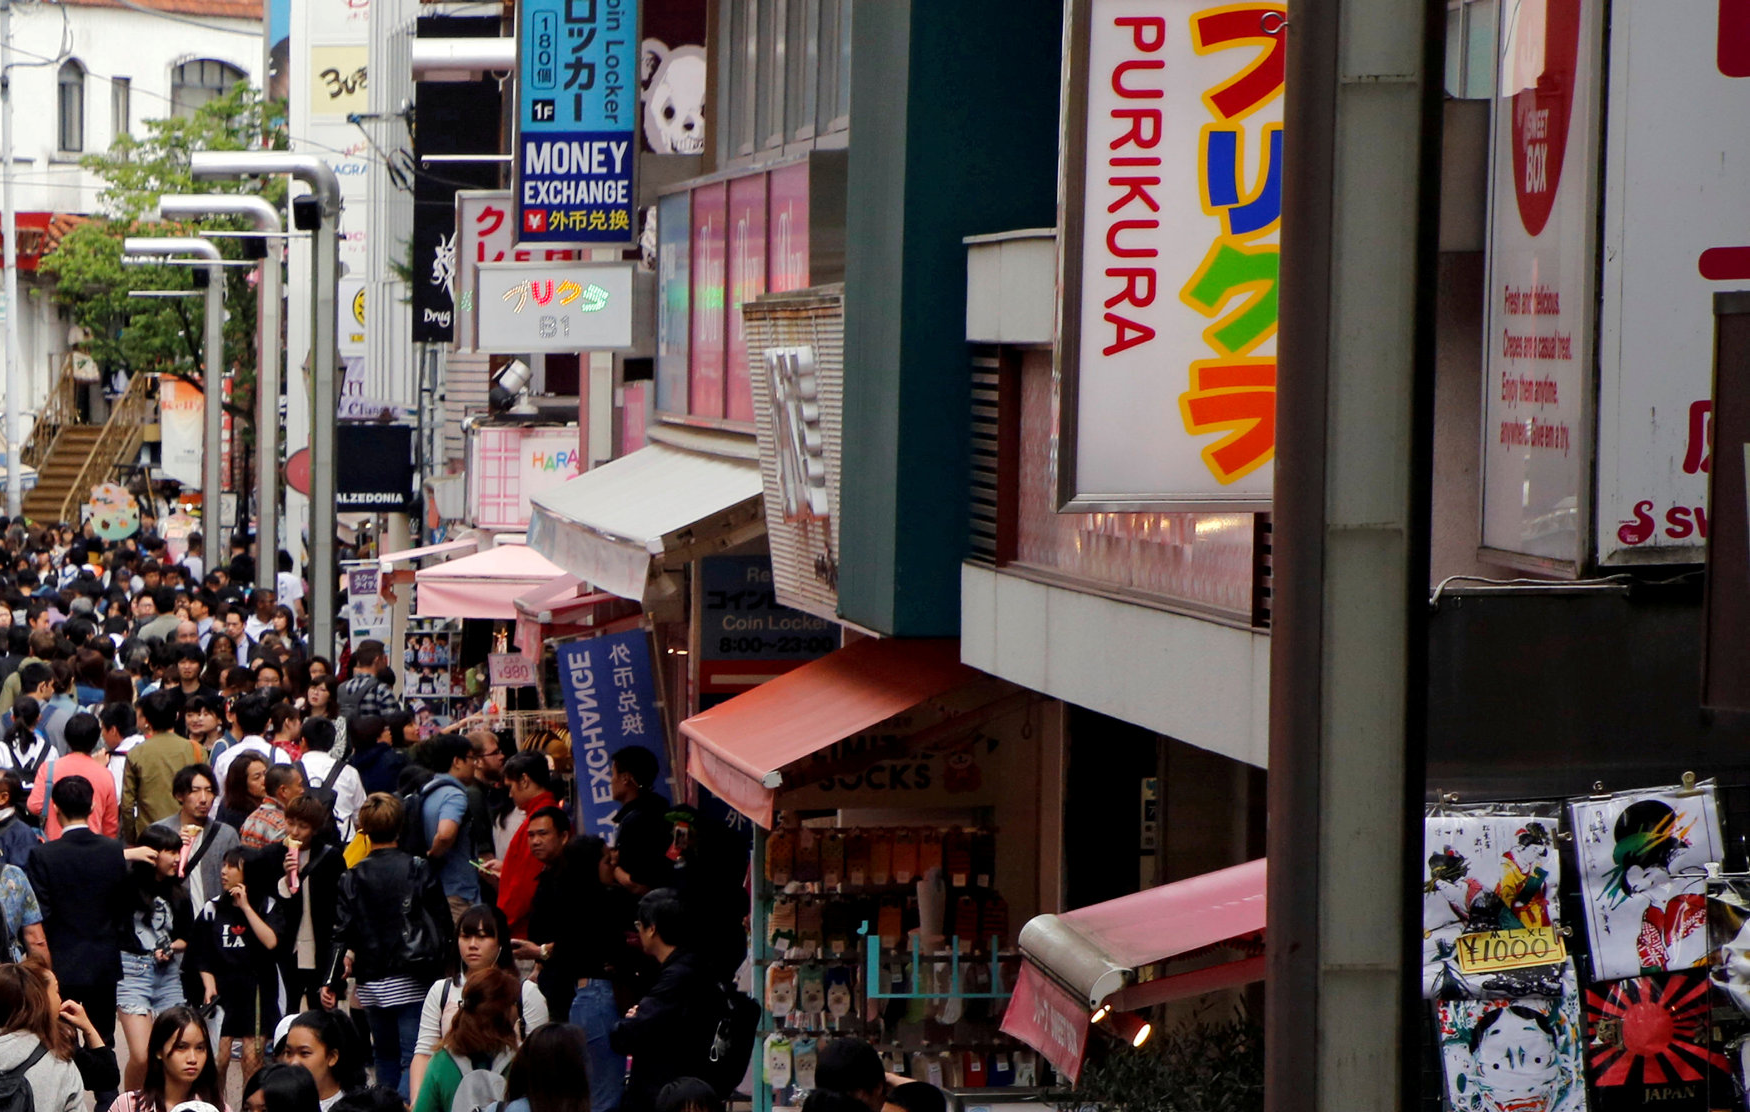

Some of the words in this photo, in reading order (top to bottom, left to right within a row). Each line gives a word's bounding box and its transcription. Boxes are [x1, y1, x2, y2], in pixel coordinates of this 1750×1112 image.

[604, 41, 625, 124] Locker
[534, 102, 554, 120] 1F
[525, 140, 628, 175] MONEY
[1525, 143, 1548, 193] BOX
[523, 180, 629, 205] EXCHANGE
[1102, 16, 1166, 357] PURIKURA
[548, 210, 629, 232] 外币兑换
[539, 315, 570, 338] B1
[722, 614, 763, 631] Coin
[222, 936, 246, 948] LA
[1463, 937, 1549, 965] ¥1000
[1642, 1085, 1696, 1104] JAPAN
